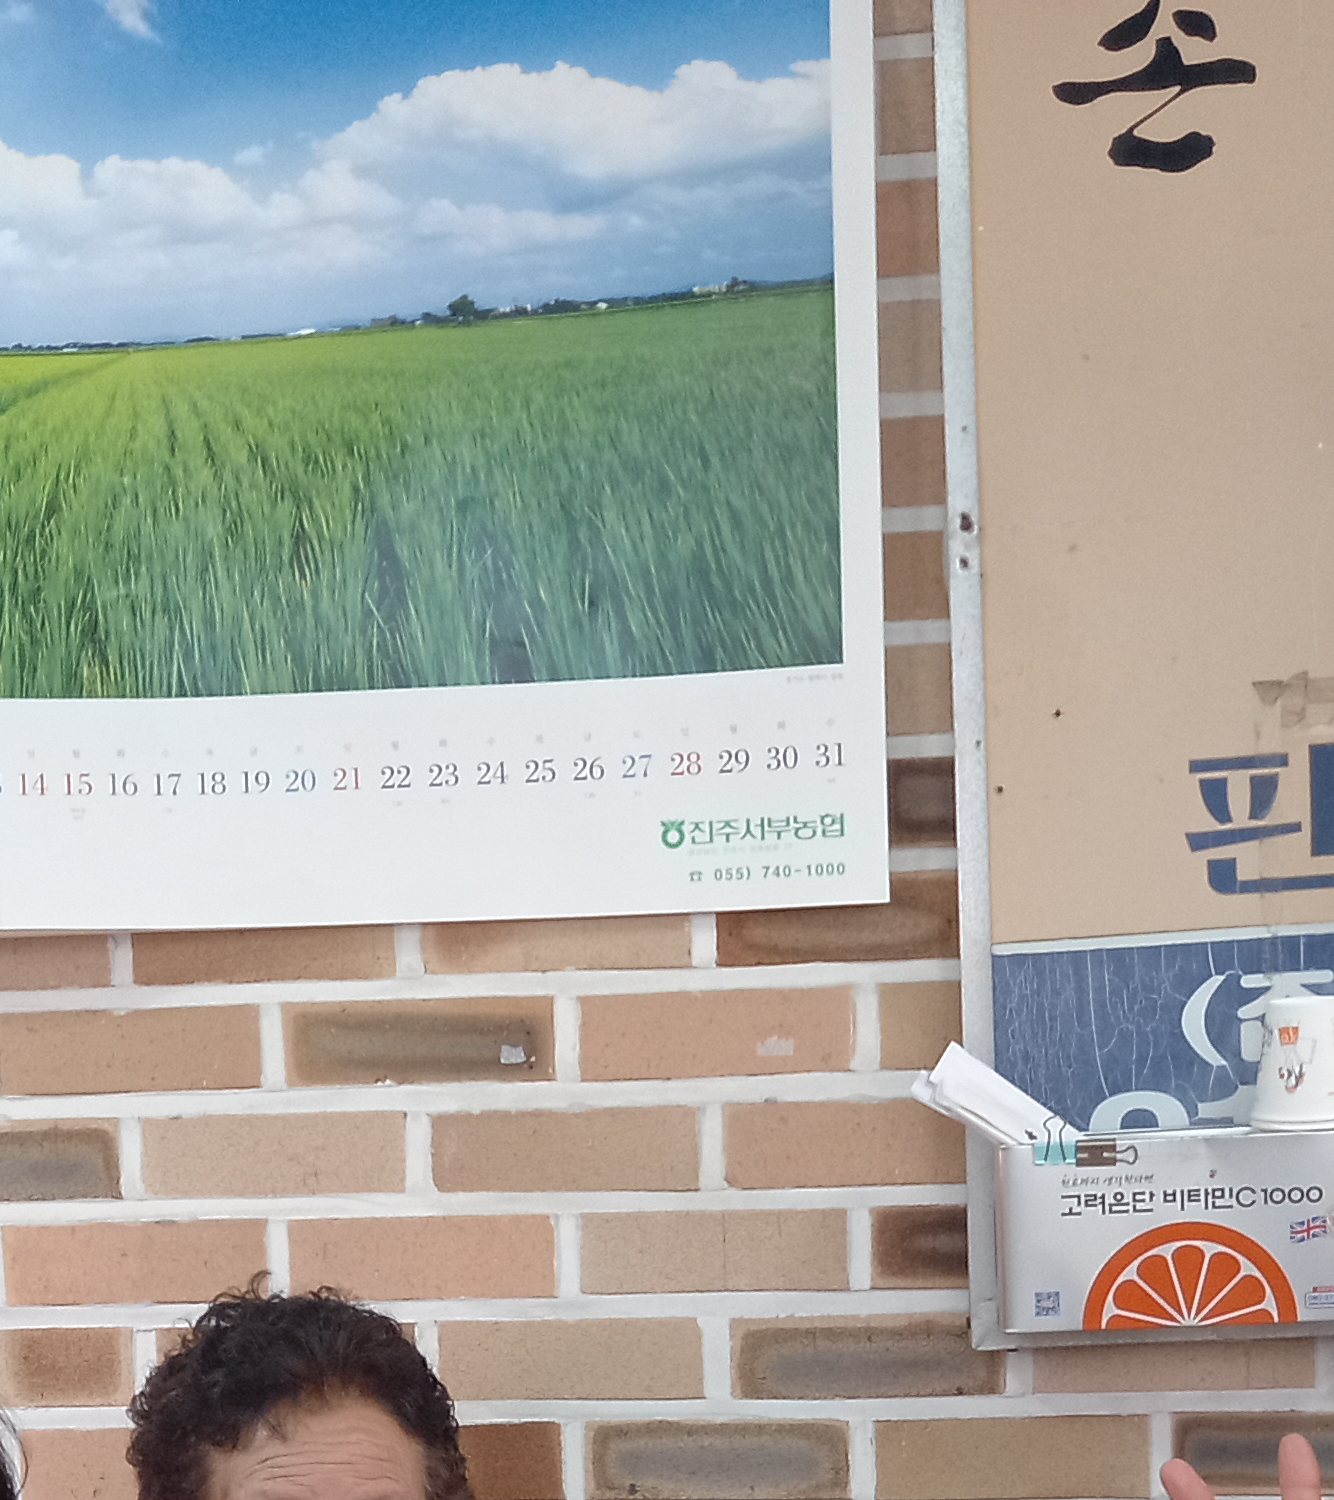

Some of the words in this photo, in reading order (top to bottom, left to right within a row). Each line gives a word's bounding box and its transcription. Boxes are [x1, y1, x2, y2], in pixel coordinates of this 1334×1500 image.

[20, 772, 48, 796] 14
[65, 772, 93, 796] 15
[109, 772, 138, 797] 16
[155, 772, 182, 797] 17
[197, 771, 227, 796] 18
[242, 770, 271, 795] 19
[284, 769, 317, 793] 20
[332, 766, 360, 791] 21
[380, 764, 412, 790] 22
[428, 762, 460, 788] 23
[476, 760, 509, 786] 24
[524, 758, 557, 784] 25
[572, 756, 605, 782] 26
[621, 753, 653, 779] 27
[670, 751, 702, 777] 28
[718, 748, 750, 775] 29
[766, 745, 799, 771] 30
[814, 742, 846, 768] 31
[688, 812, 846, 846] 진주서부농협
[713, 866, 752, 882] 055)
[761, 862, 846, 880] 740-1000
[1060, 1189, 1156, 1217] 고려은단
[1162, 1185, 1257, 1211] 비타민C
[1261, 1184, 1324, 1206] 1000
